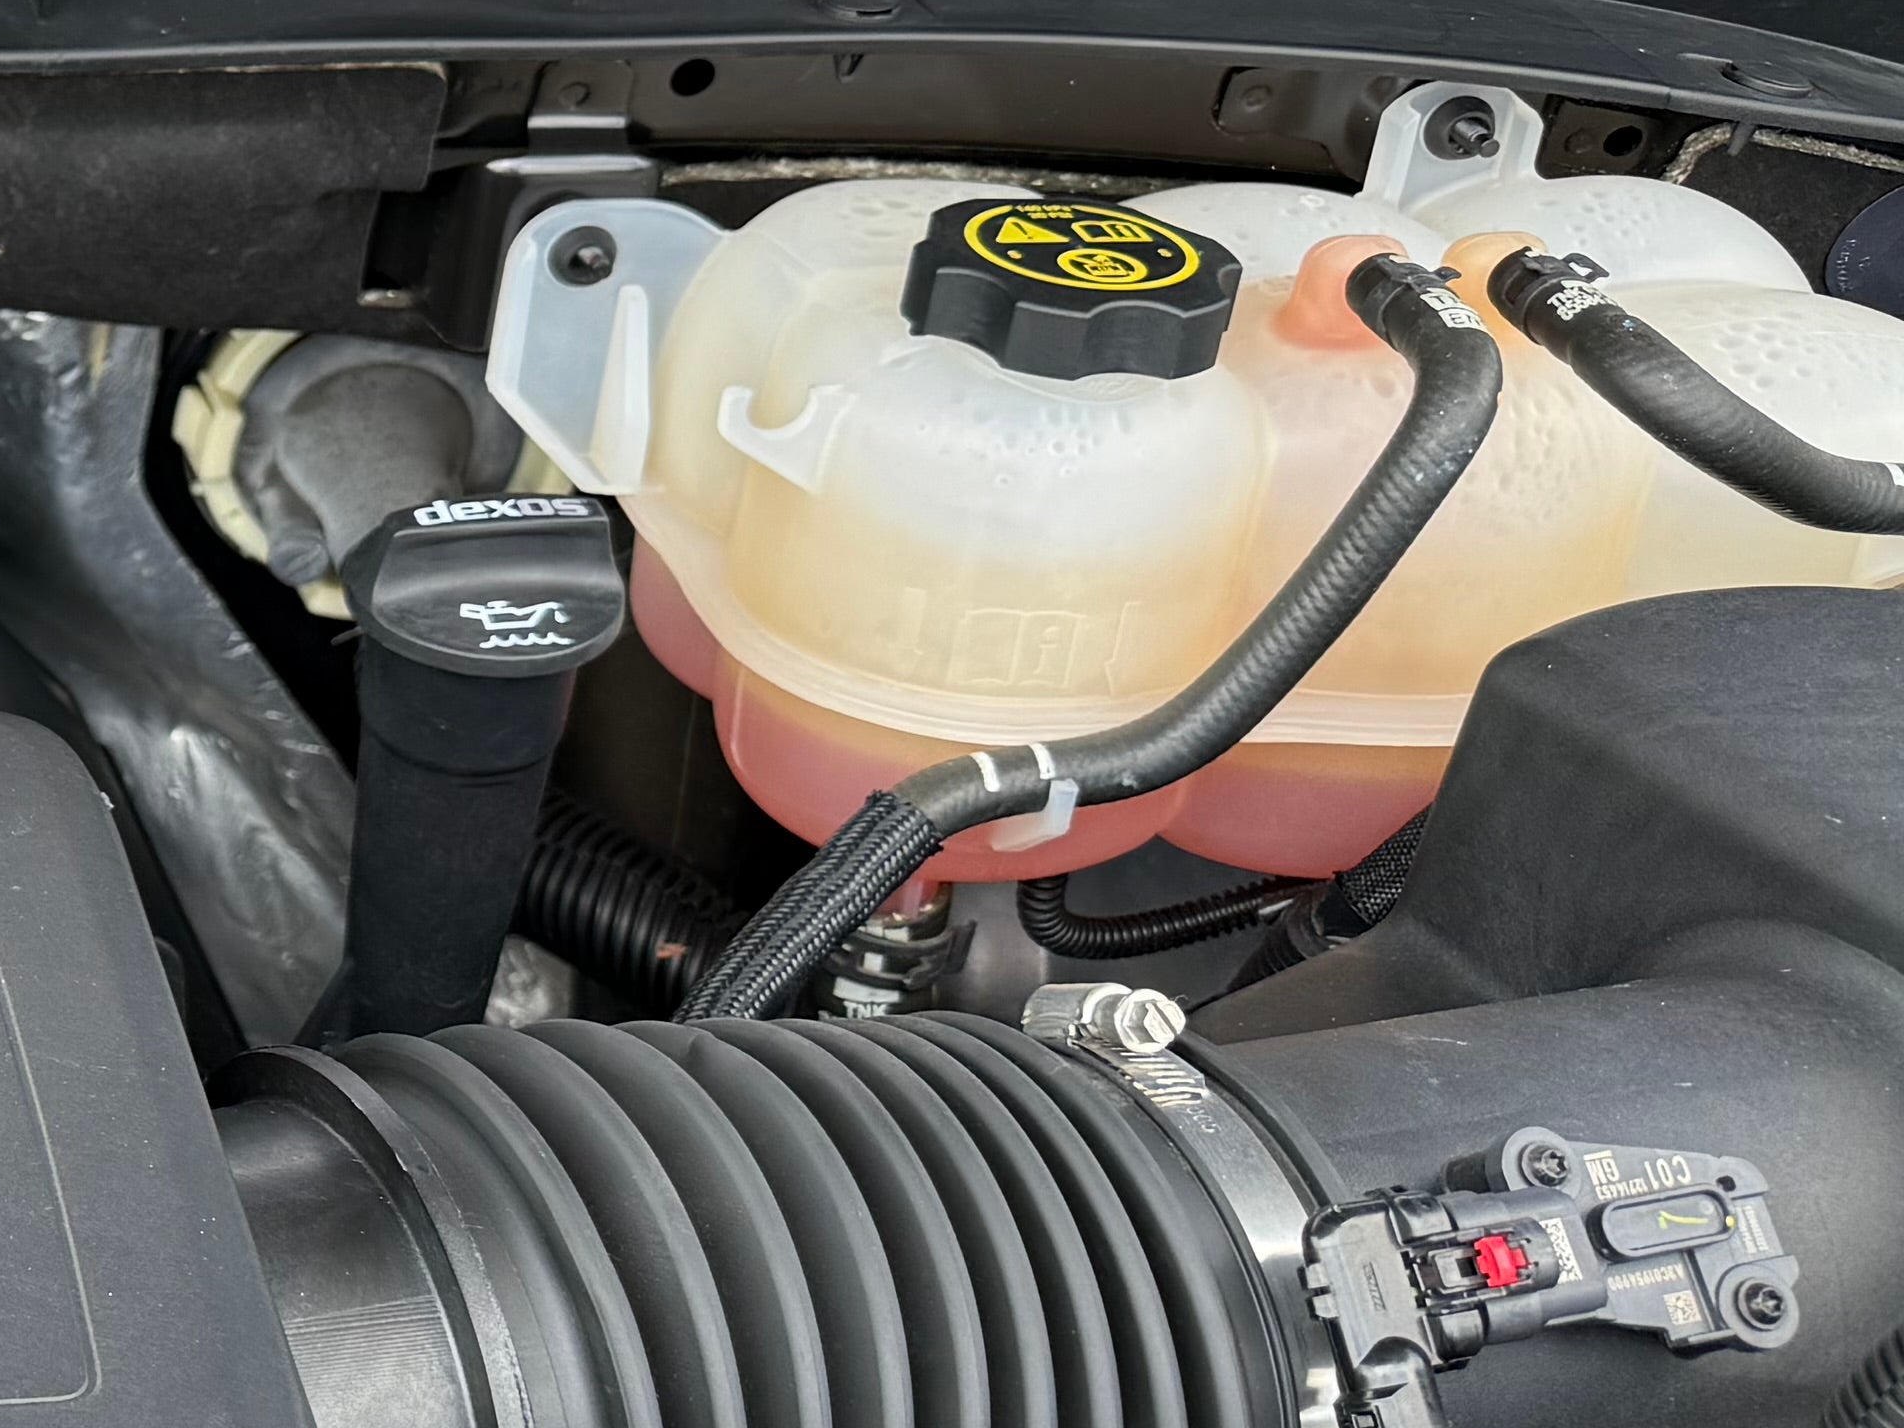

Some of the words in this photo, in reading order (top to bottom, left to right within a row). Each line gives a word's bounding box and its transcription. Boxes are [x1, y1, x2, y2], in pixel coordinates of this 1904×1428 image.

[413, 497, 589, 526] dexos
[1583, 1155, 1620, 1185] GM
[1644, 1154, 1692, 1189] C01
